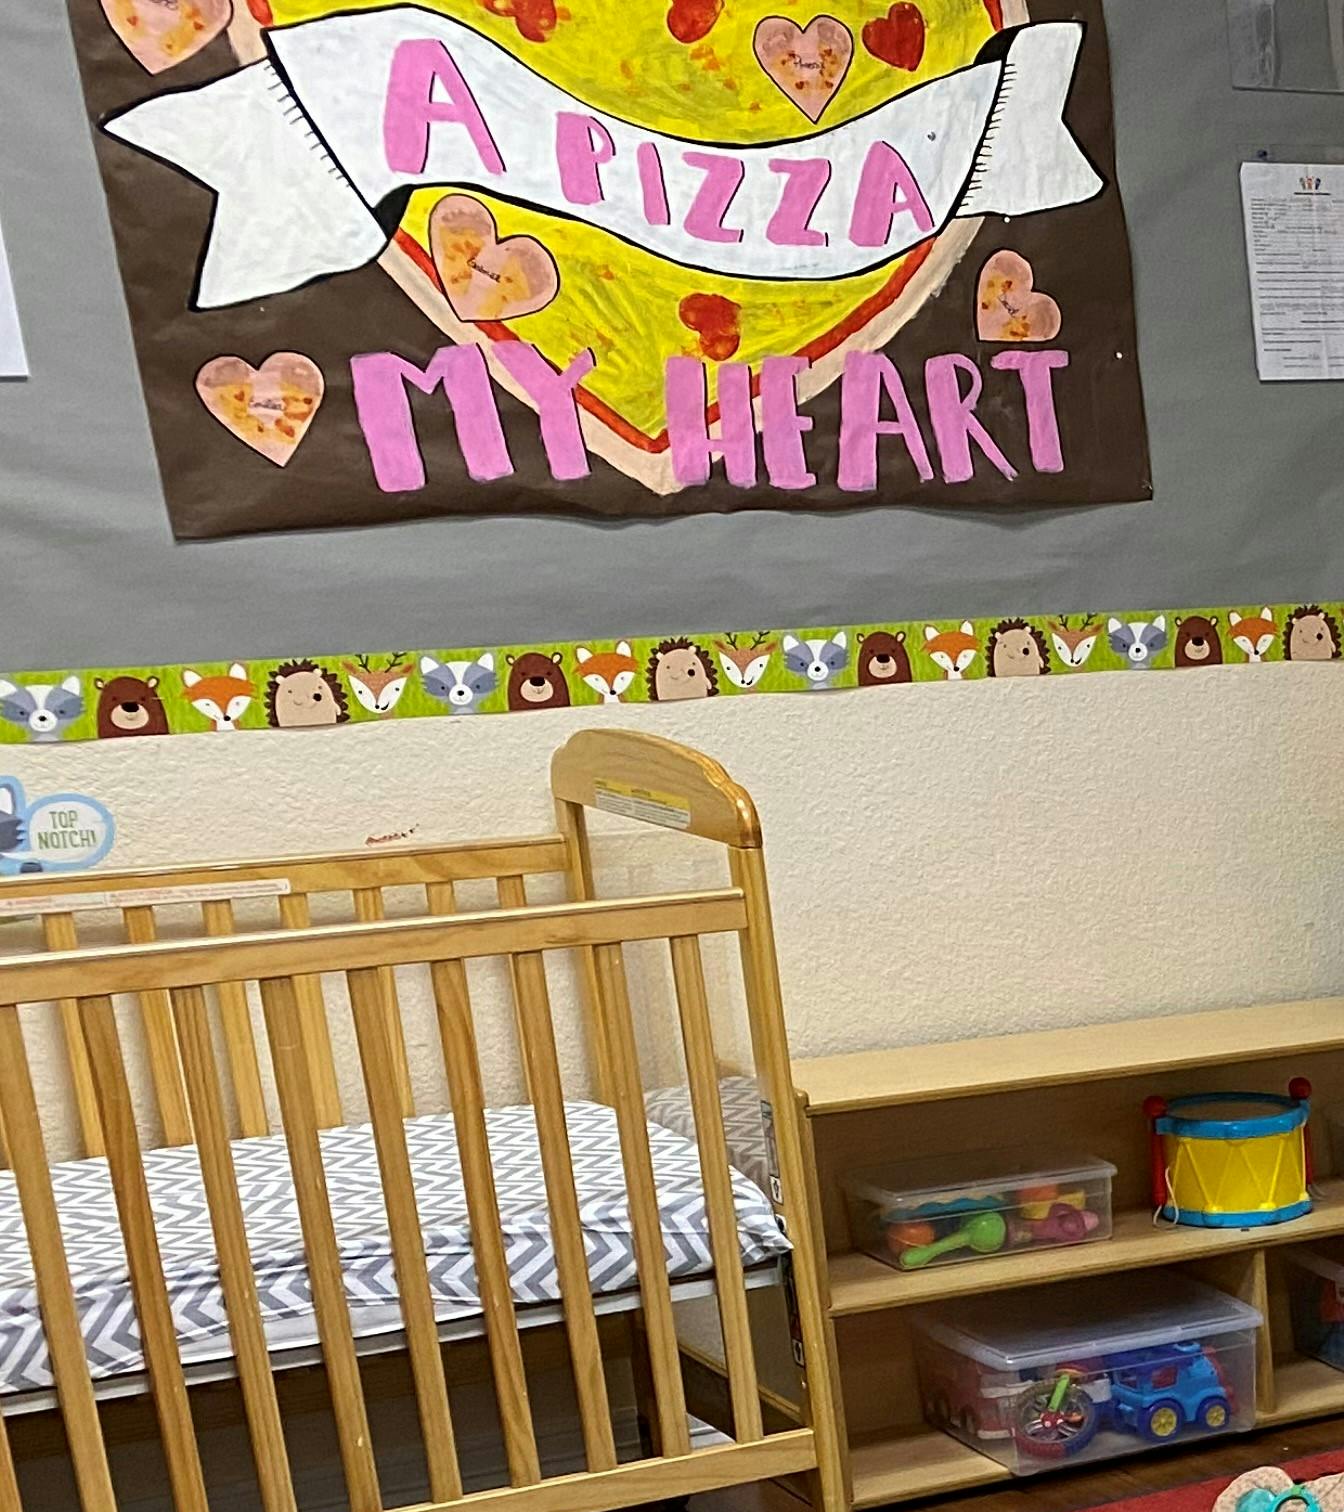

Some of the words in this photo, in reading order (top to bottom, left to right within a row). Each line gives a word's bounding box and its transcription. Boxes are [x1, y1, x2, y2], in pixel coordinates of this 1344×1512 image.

[384, 38, 504, 176] A
[555, 110, 936, 248] PIZZA
[350, 340, 597, 493] MY
[661, 349, 1070, 492] HEART
[37, 829, 97, 850] NOTCH!
[49, 810, 78, 829] TOP
